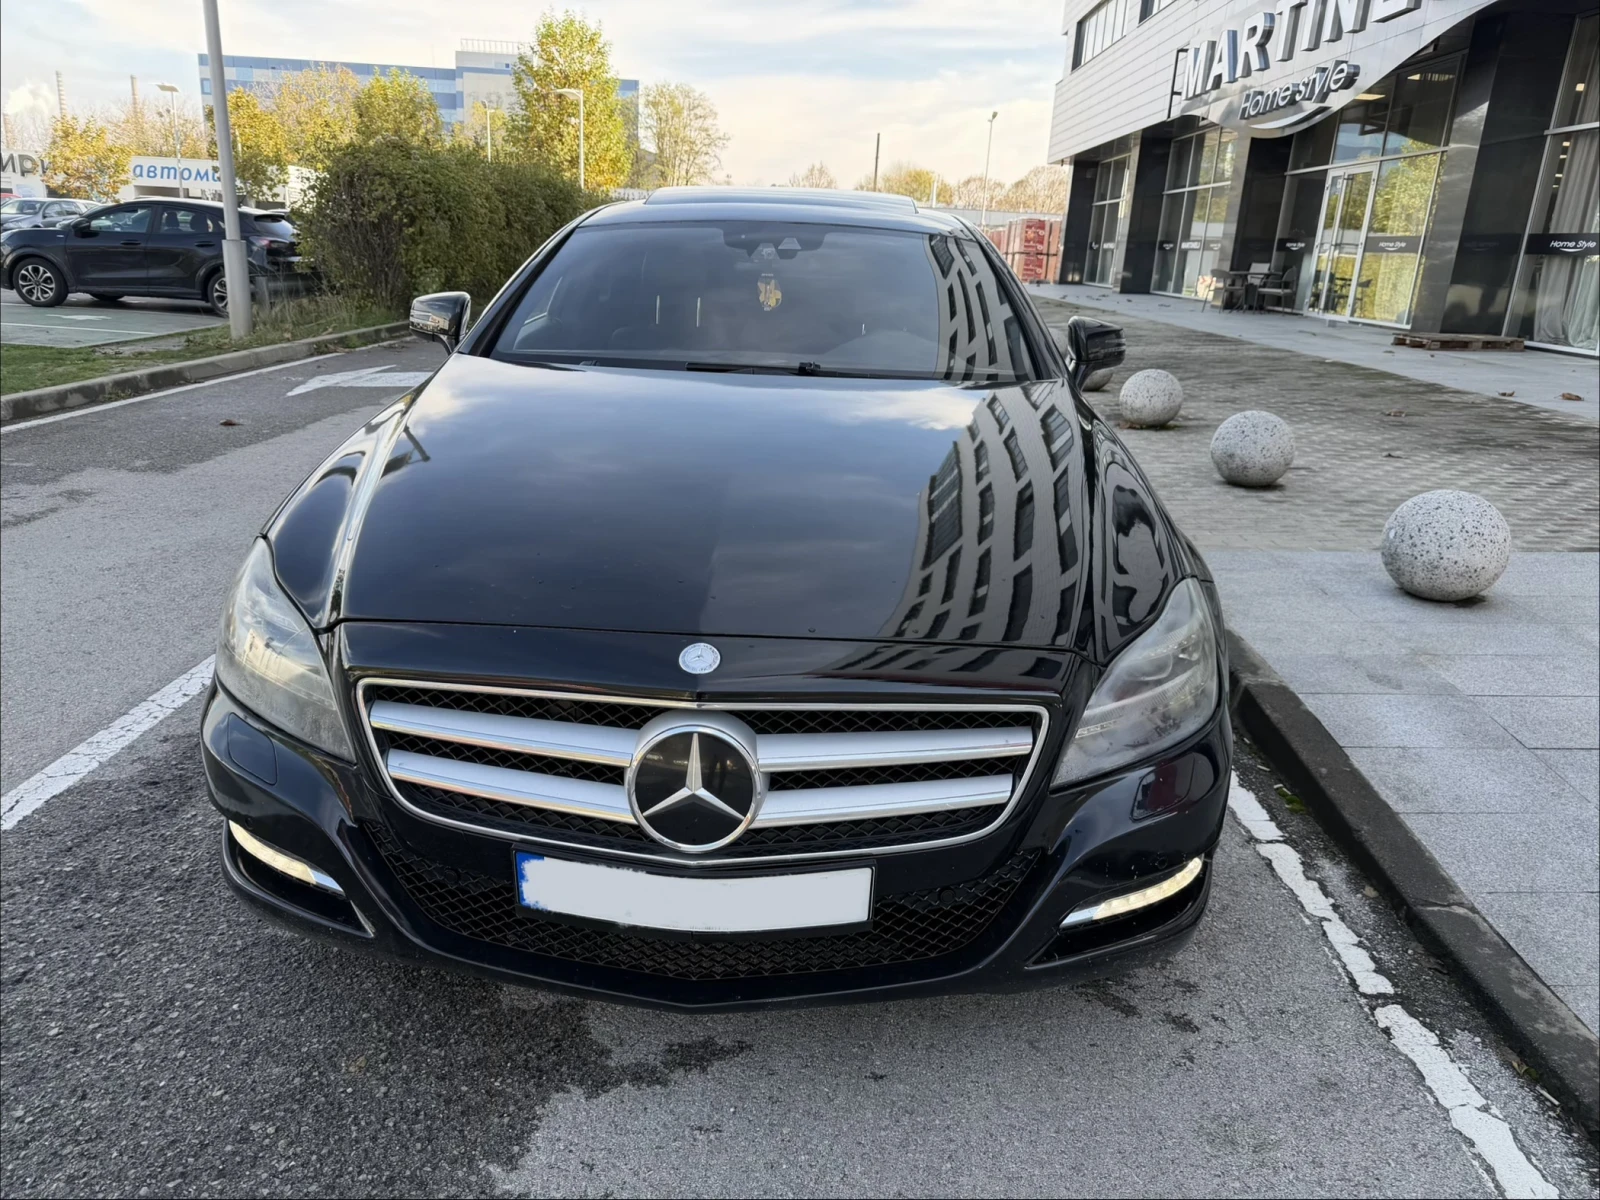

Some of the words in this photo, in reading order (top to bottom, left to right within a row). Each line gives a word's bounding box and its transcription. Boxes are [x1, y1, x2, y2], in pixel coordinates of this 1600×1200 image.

[1239, 81, 1298, 119] Home
[1295, 60, 1360, 103] style
[1549, 240, 1576, 248] Home
[1576, 240, 1598, 250] Style
